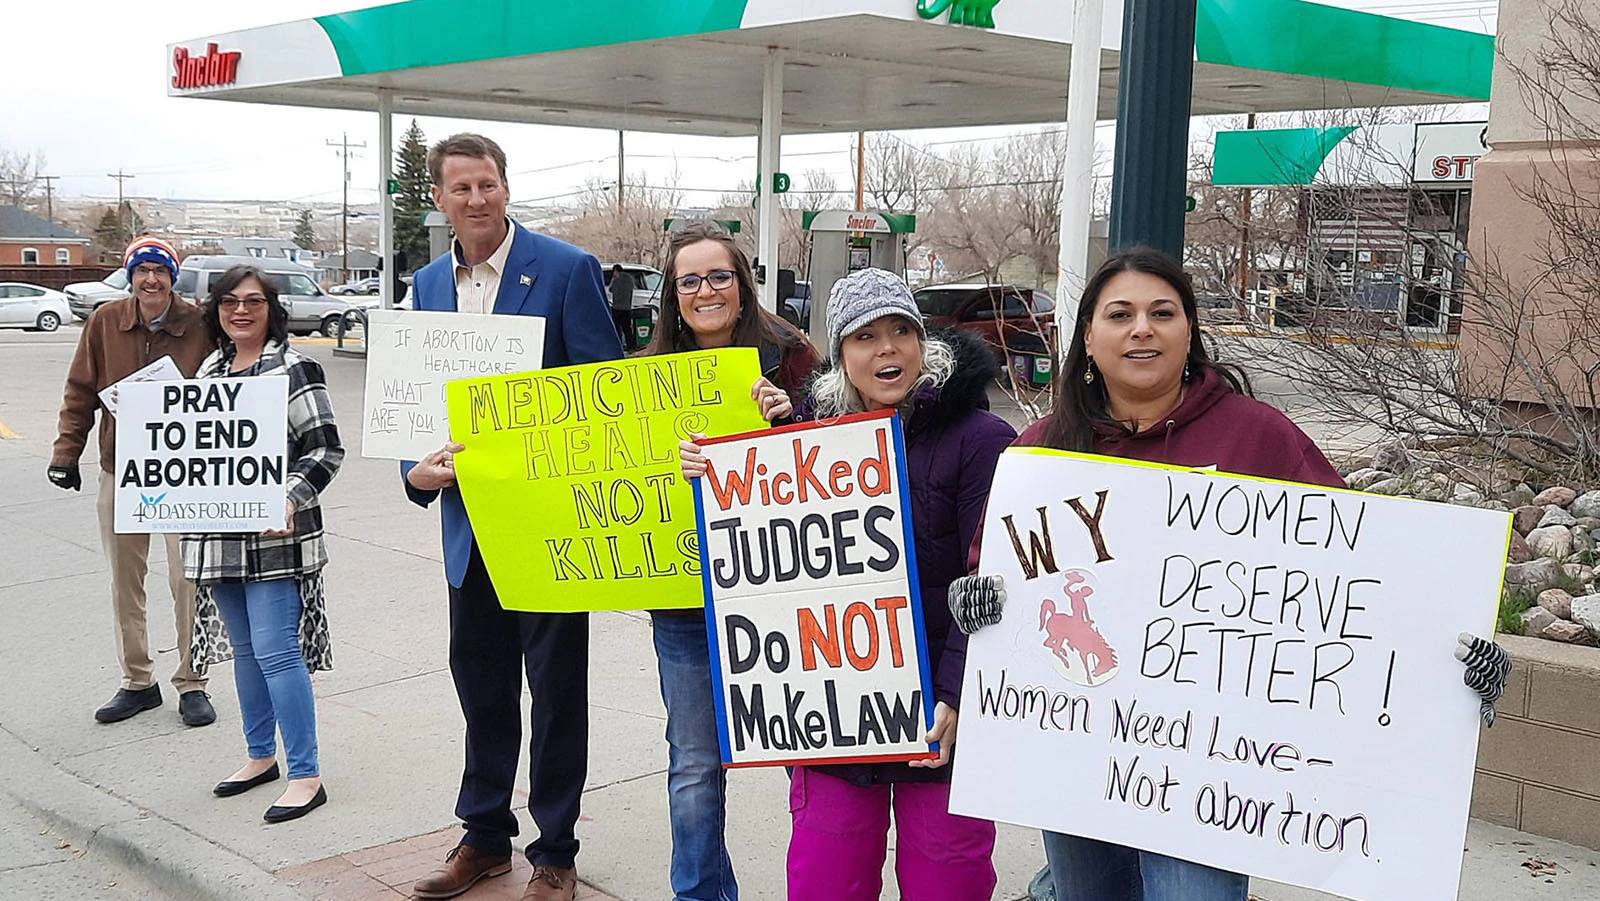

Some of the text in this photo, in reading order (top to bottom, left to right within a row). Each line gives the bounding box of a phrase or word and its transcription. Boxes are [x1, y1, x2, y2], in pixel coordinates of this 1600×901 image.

[172, 43, 242, 89] Sinclair
[779, 177, 786, 190] 3
[1432, 155, 1481, 179] ST
[847, 214, 877, 230] Sinclair
[394, 329, 525, 354] IF ABORTION IS
[424, 355, 516, 375] HEALTHCARE
[163, 382, 243, 414] PRAY
[382, 379, 431, 404] WHAT
[468, 354, 722, 434] MEDICINE
[145, 419, 258, 451] TO END
[370, 407, 436, 439] ARE YOU
[120, 456, 283, 488] ABORTION
[705, 428, 892, 510] Wicked
[571, 472, 676, 529] NOT
[1166, 475, 1366, 551] WOMEN
[545, 529, 702, 582] KILLS
[710, 505, 900, 589] JUDGES
[1001, 490, 1115, 581] WY
[1159, 555, 1381, 640] DESERVE
[724, 596, 908, 675] Do NOT
[977, 669, 1092, 736] Women
[1113, 699, 1189, 751] Need
[1107, 755, 1382, 865] Not abortion.
